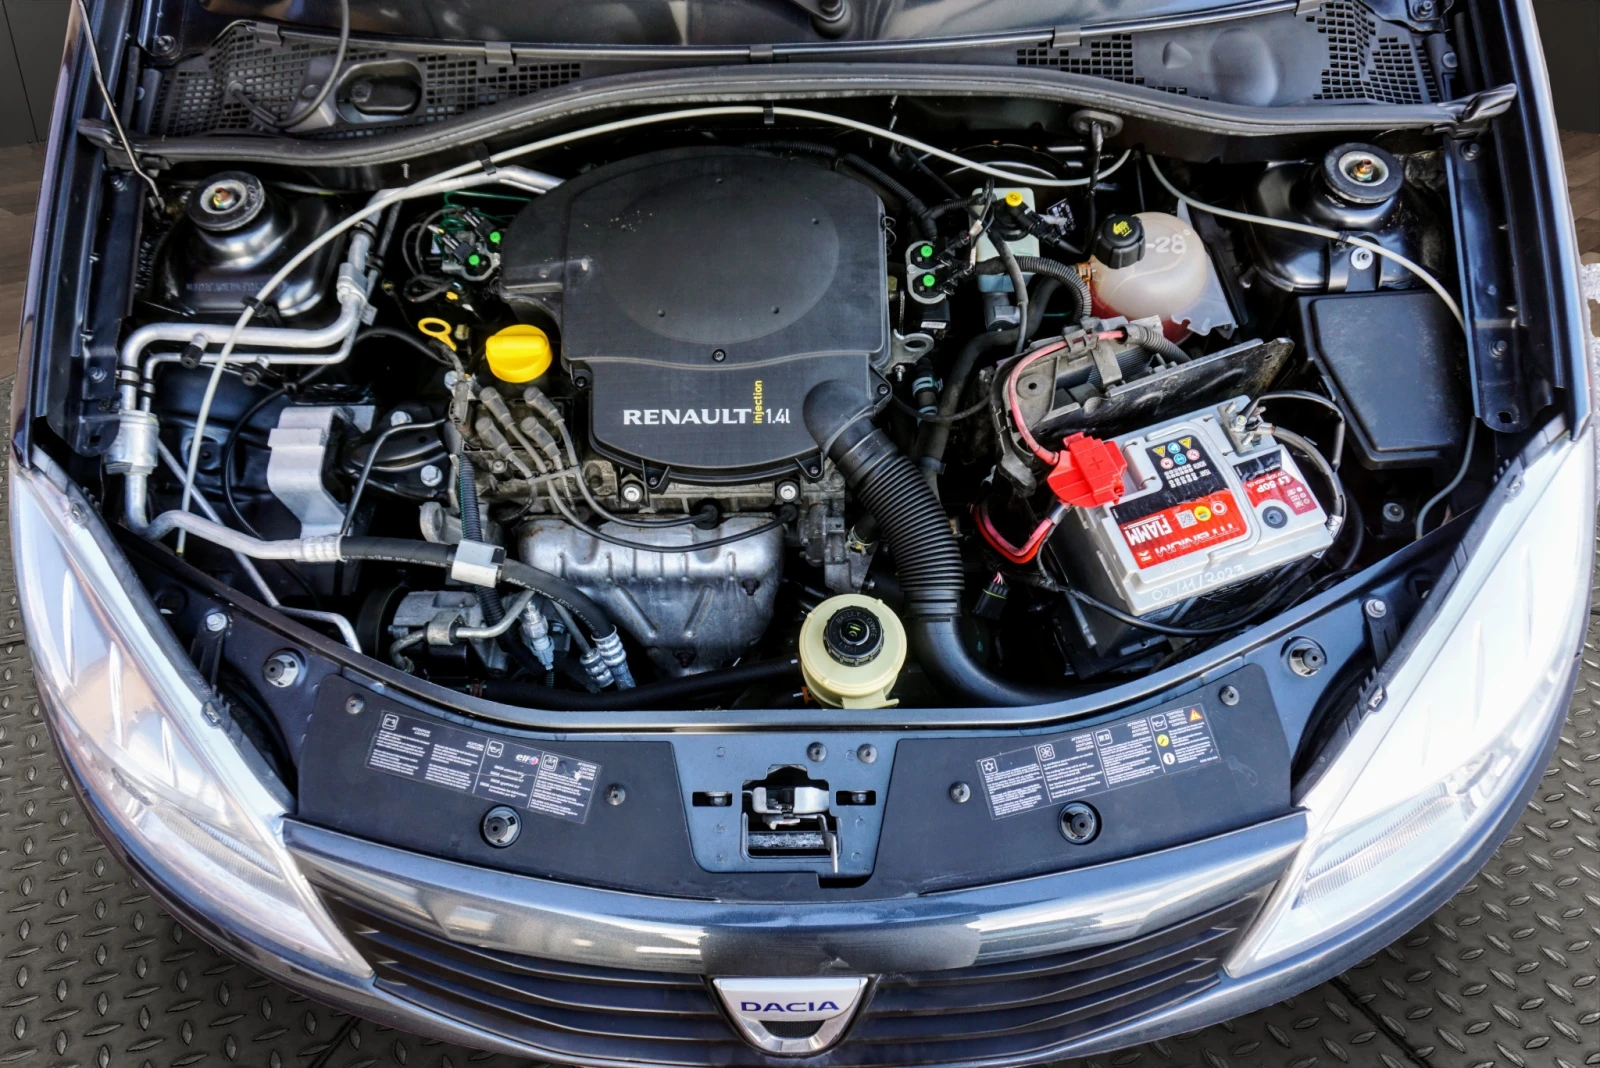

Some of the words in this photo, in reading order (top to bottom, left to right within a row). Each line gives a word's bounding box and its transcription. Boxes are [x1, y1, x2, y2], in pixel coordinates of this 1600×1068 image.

[623, 408, 752, 425] RENAULT
[752, 380, 763, 424] injection
[1257, 480, 1277, 493] 50P
[1278, 475, 1291, 485] L1
[1124, 518, 1173, 546] FIAMM
[1155, 523, 1239, 557] TITANIUM
[516, 754, 531, 763] elf
[740, 1001, 840, 1012] DACIA
